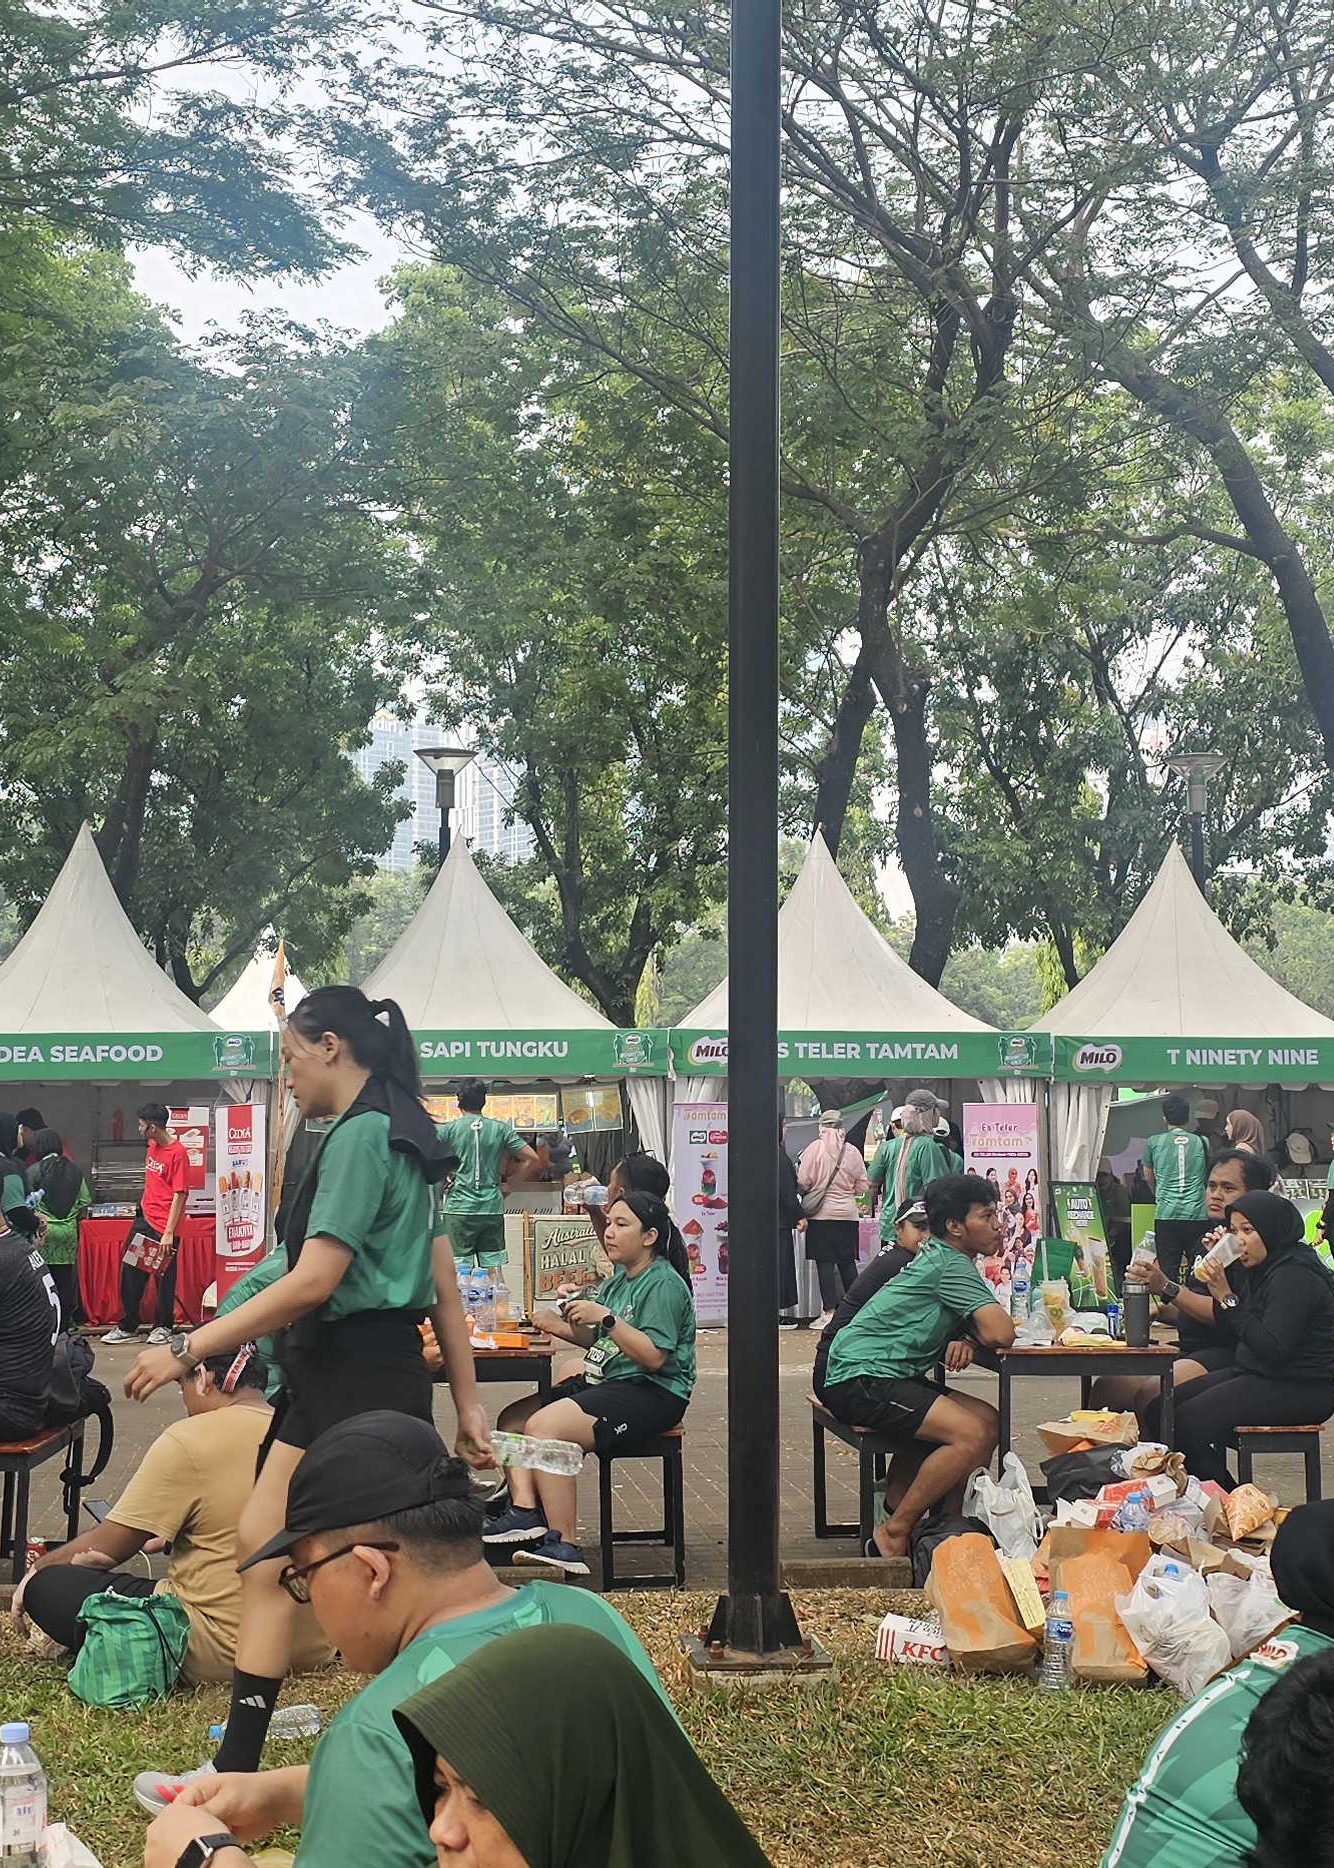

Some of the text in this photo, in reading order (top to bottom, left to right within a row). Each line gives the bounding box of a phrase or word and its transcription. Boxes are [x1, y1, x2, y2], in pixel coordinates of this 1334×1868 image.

[50, 1045, 164, 1063] SEAFOOD
[419, 1041, 568, 1058] SAPI TUNGKU
[778, 1042, 958, 1060] S TELER TAMTAM
[1079, 1050, 1117, 1065] MILO
[1167, 1049, 1319, 1066] T NINETY NINE
[228, 1127, 252, 1140] CEDEA
[981, 1122, 1018, 1132] Es Teler
[969, 1133, 1023, 1147] Tamtam
[540, 1249, 586, 1270] HALAL
[901, 1640, 945, 1662] KFC
